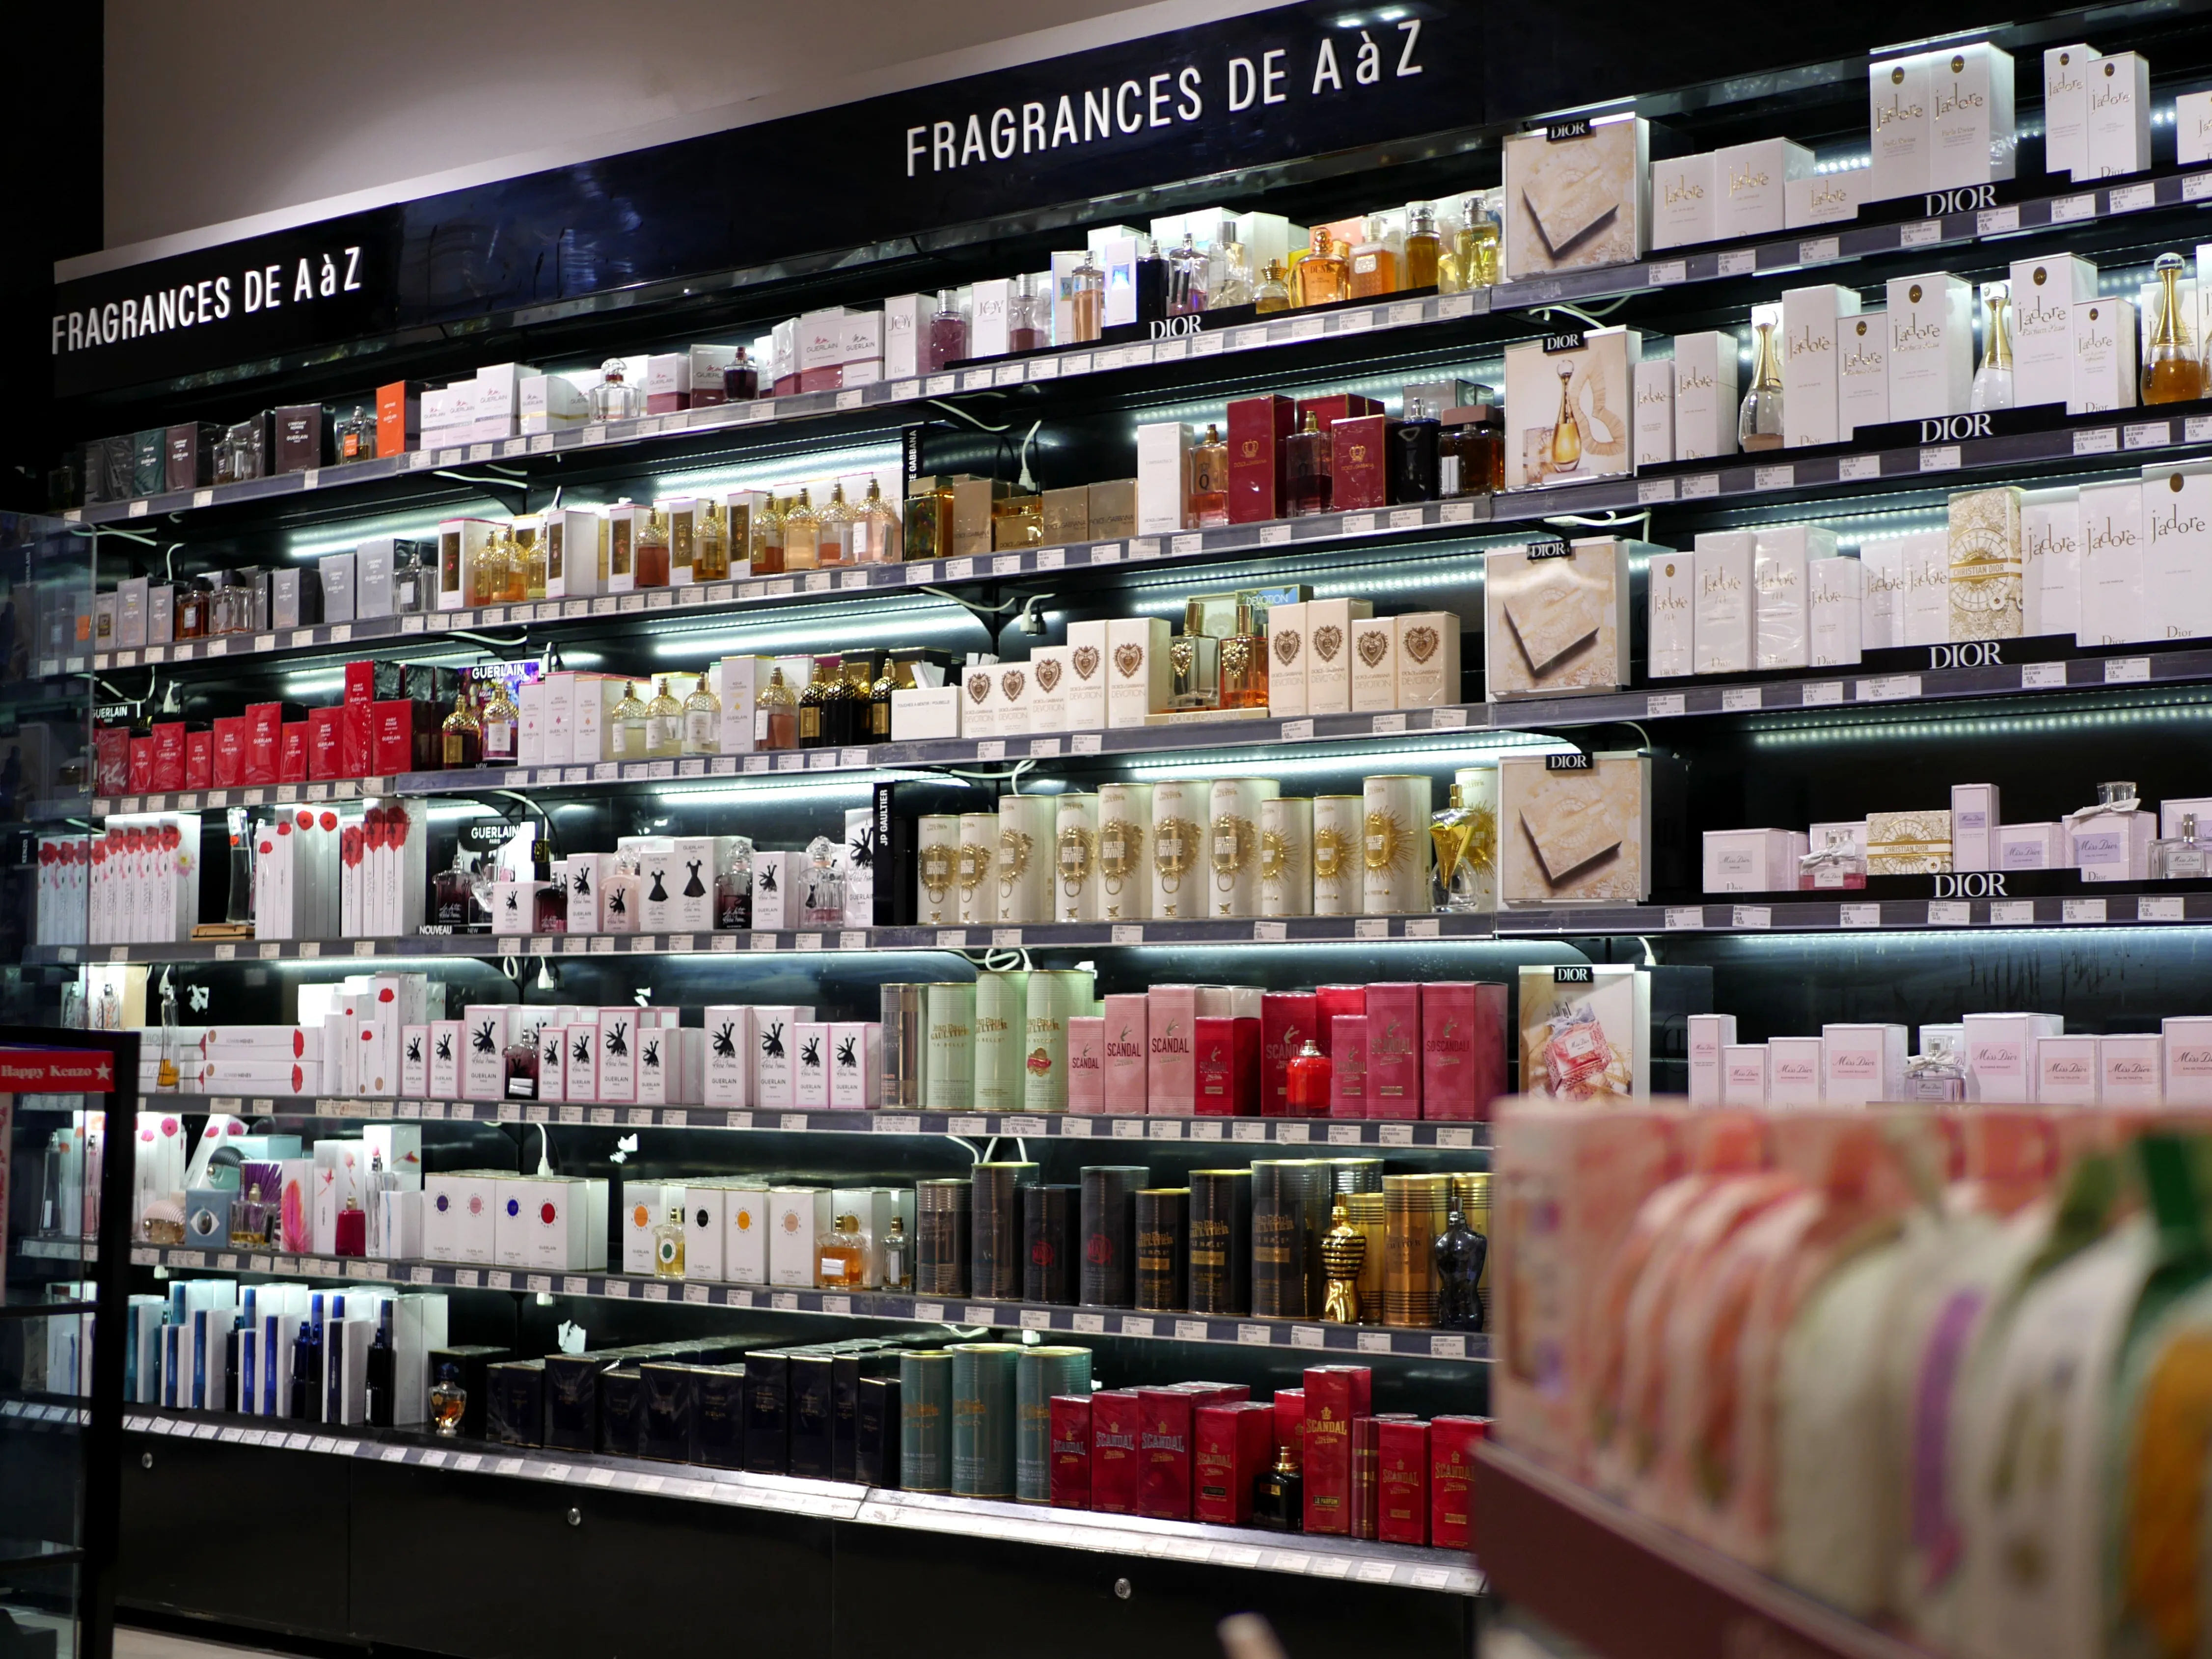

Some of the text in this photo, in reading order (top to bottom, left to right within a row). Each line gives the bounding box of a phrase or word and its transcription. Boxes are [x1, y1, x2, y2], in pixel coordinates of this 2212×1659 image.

[907, 19, 1422, 177] FRAGRANCES DE A à Z
[1551, 122, 1585, 139] DIOR
[1925, 186, 1997, 217] DIOR
[52, 246, 361, 354] FRAGRANCES DE A à Z
[978, 300, 1004, 317] JOY
[888, 313, 913, 331] JOY
[1150, 315, 1202, 339] DIOR
[806, 343, 838, 353] GUERLAIN
[846, 341, 875, 352] GUERLAIN
[1547, 334, 1579, 351] DIOR
[480, 395, 508, 404] GUERLAIN
[1920, 413, 1994, 443] DIOR
[1199, 473, 1210, 490] Q
[1531, 542, 1566, 558] DIOR
[1953, 563, 2005, 577] CHRISTIAN DIOR
[2166, 626, 2193, 638] Dior
[1929, 642, 2003, 670] DIOR
[472, 663, 525, 679] GUERLAIN
[1551, 755, 1587, 768] DIOR
[471, 825, 519, 840] GUERLAIN
[880, 834, 888, 845] JP
[1884, 843, 1929, 854] CHRISTIAN DIOR
[2007, 846, 2042, 858] Miss Dior
[2076, 839, 2119, 852] Miss Dior
[2088, 870, 2107, 882] Dior
[1933, 873, 2008, 898] DIOR
[419, 925, 452, 935] NOUVEAU
[1557, 968, 1587, 981] DIOR
[1107, 1042, 1141, 1057] SCANDAL
[1152, 1038, 1190, 1054] SCANDAL
[1371, 1038, 1413, 1055] SCANDAL
[1427, 1040, 1436, 1052] SO
[1832, 1055, 1876, 1067] Miss Dior
[1975, 1048, 2018, 1061] Miss Dior
[2174, 1051, 2212, 1063] Miss Di
[1072, 1057, 1099, 1069] SCANDAL
[1777, 1064, 1813, 1074] Miss Dior
[2046, 1062, 2087, 1073] Miss Dior
[2108, 1061, 2151, 1074] Miss Dior
[1, 1064, 93, 1079] Happy Kenzo
[1306, 1420, 1347, 1436] SCANDAL
[1053, 1439, 1086, 1455] SCANDAL
[1096, 1431, 1134, 1450] SCANDAL
[1142, 1432, 1185, 1453] SCANDAL
[1197, 1452, 1232, 1469] SCANDAL
[1383, 1472, 1419, 1487] SCANDAL
